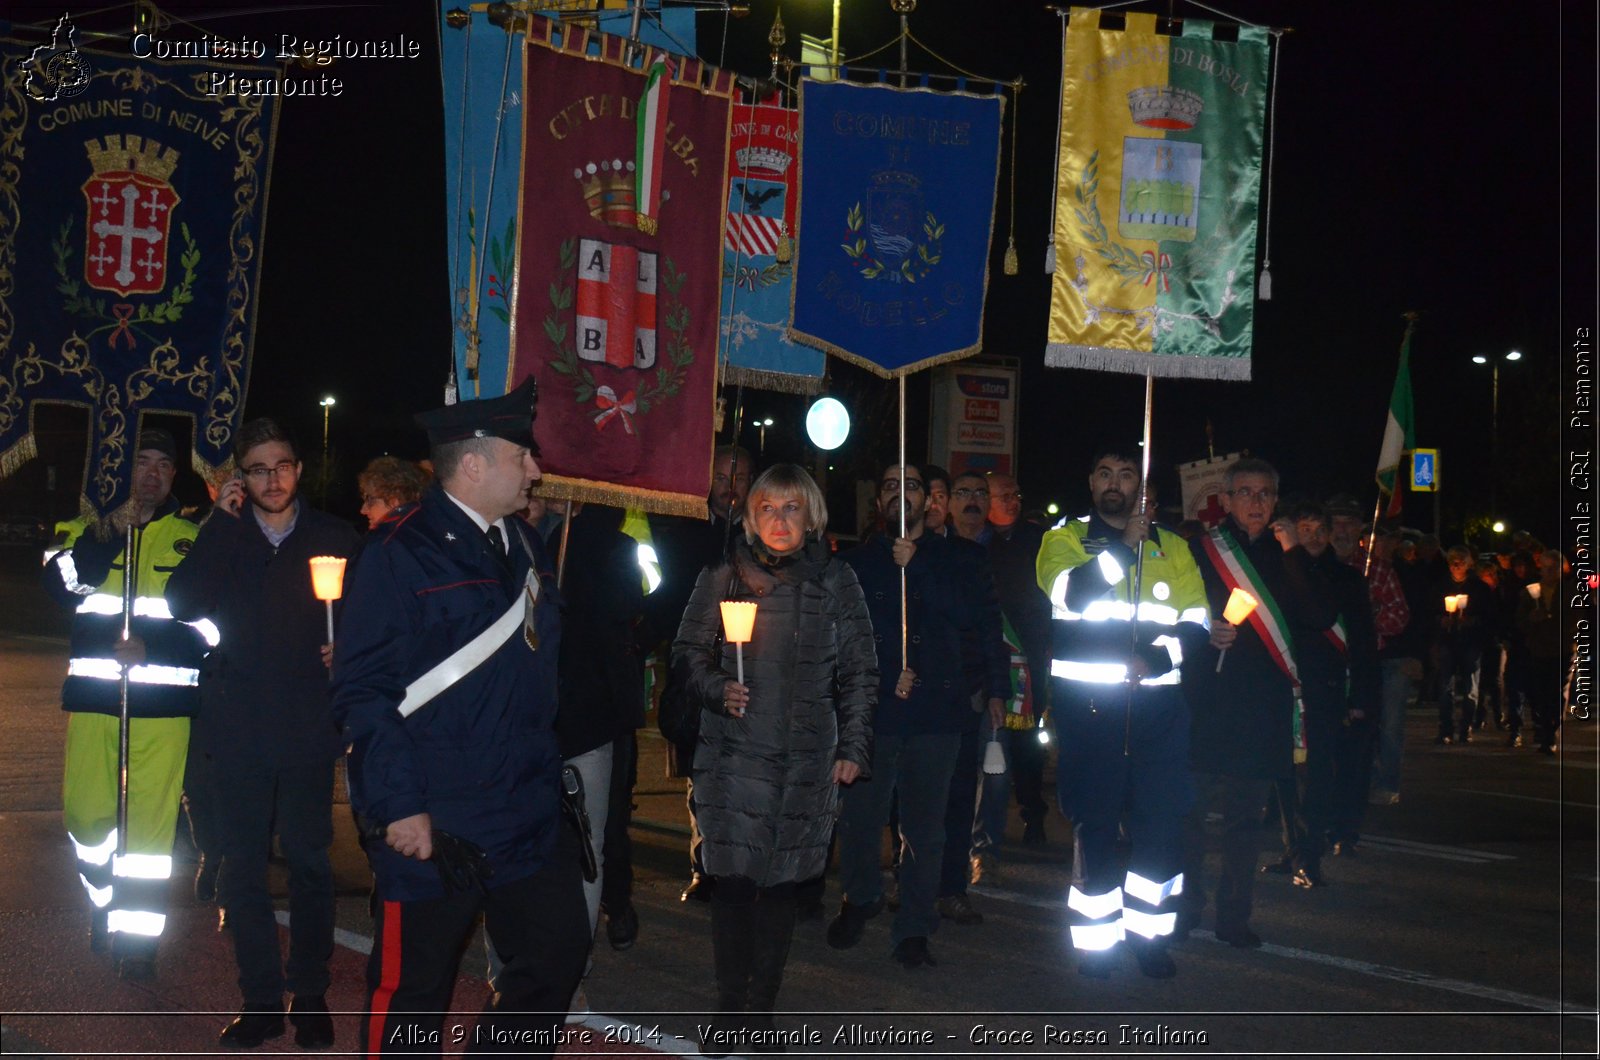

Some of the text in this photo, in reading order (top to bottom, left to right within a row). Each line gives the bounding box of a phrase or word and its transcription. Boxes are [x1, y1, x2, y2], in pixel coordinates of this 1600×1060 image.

[1173, 47, 1195, 67] DI
[1197, 53, 1250, 98] BOSIA
[38, 98, 231, 152] COMUNE DI NEIVE
[775, 124, 798, 144] CAS
[833, 110, 971, 146] COMUNE
[586, 248, 606, 273] A
[583, 327, 647, 360] B A
